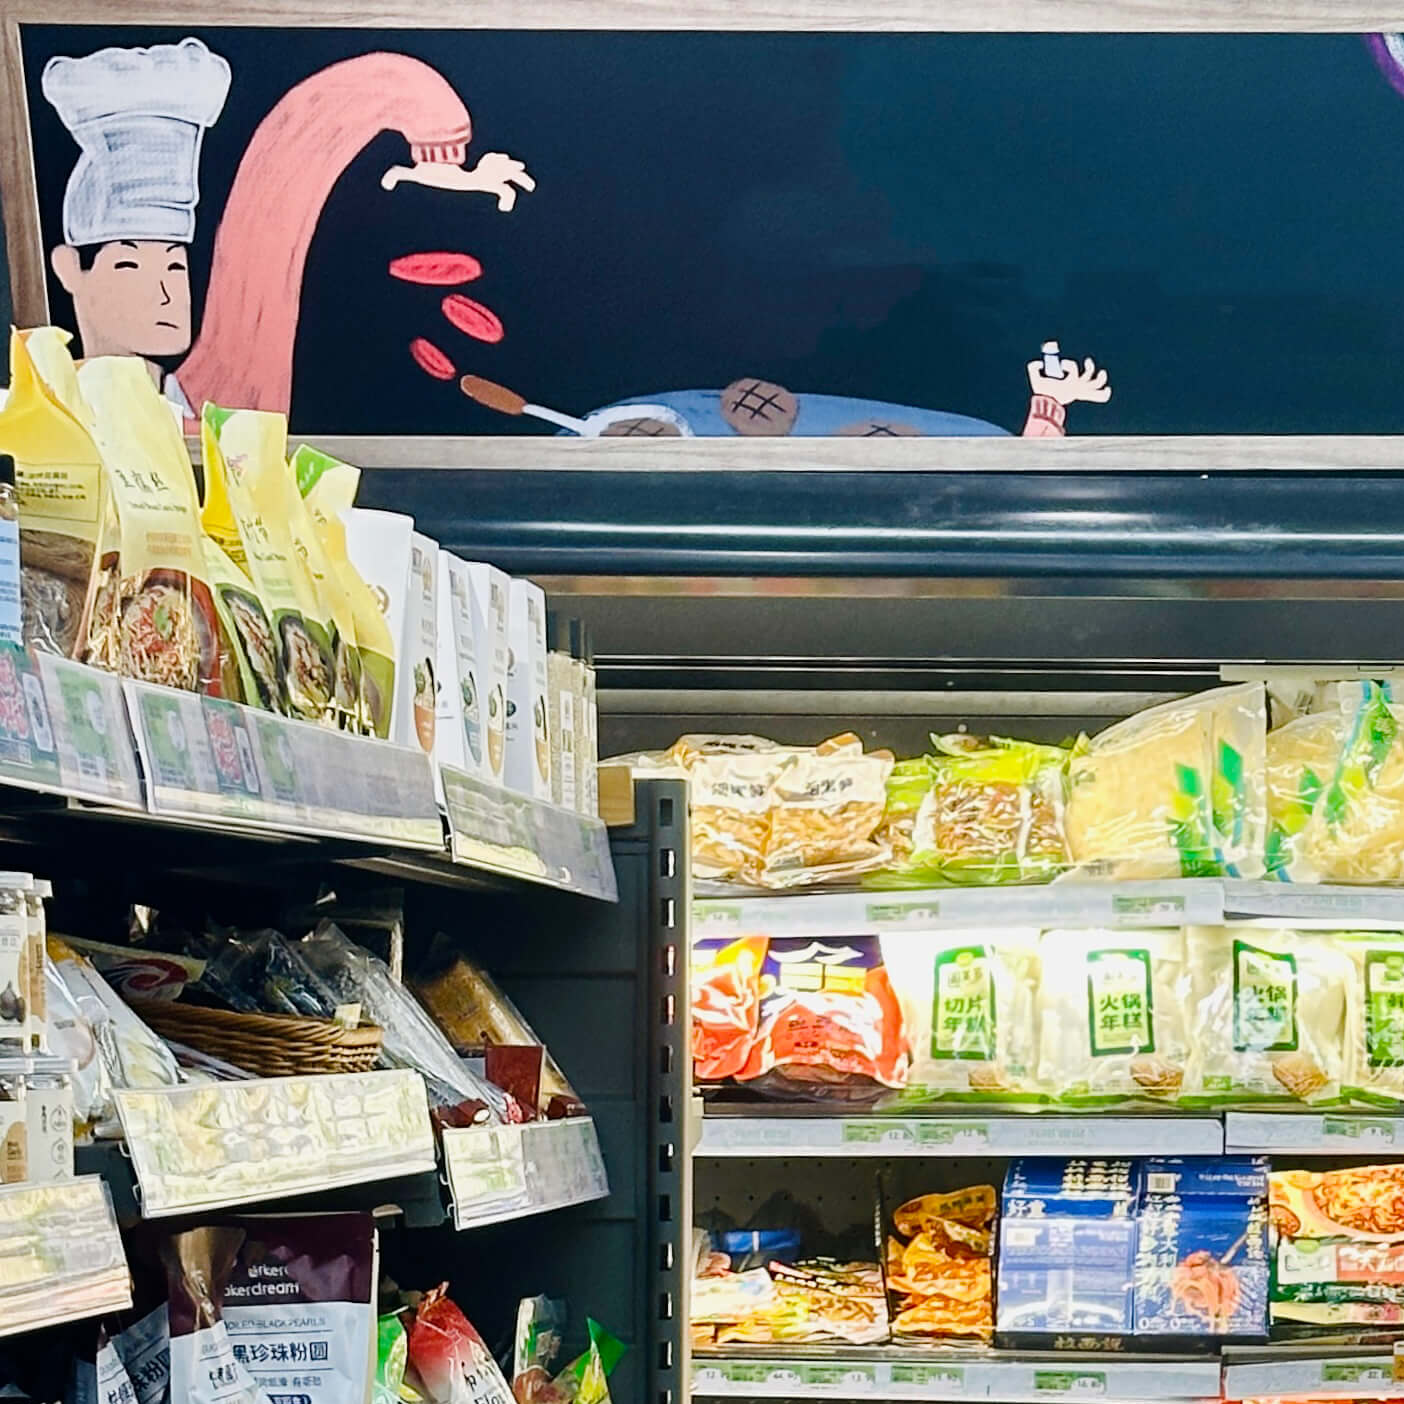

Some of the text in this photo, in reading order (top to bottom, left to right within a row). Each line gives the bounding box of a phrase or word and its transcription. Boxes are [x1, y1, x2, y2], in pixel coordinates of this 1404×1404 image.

[944, 996, 984, 1014] 切片
[1100, 993, 1142, 1012] 火锅
[1100, 1013, 1142, 1030] 年糕
[224, 1282, 300, 1297] akerdream
